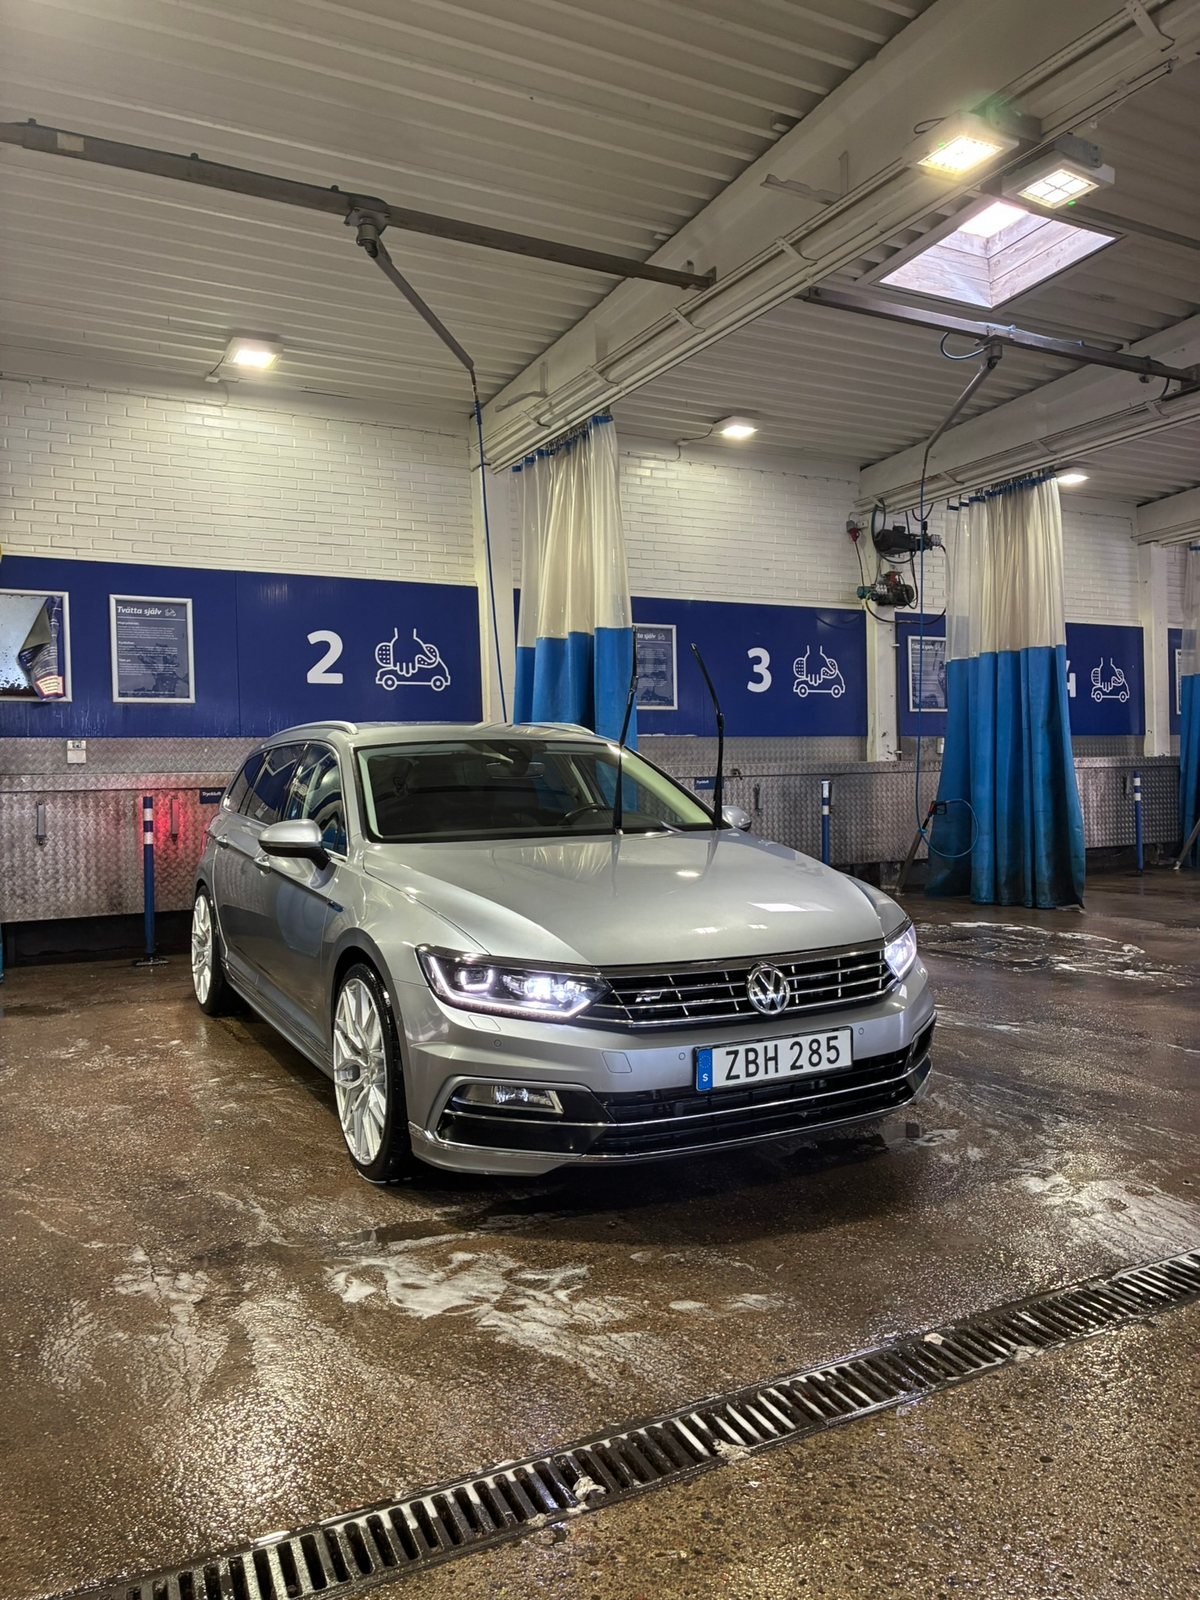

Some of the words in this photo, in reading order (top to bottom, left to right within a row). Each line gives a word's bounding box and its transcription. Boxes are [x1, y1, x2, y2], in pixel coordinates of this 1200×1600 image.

[117, 606, 142, 614] Tvätta
[144, 607, 162, 616] själv
[307, 630, 343, 684] 2
[747, 647, 772, 693] 3
[702, 1073, 709, 1082] S
[725, 1043, 779, 1082] ZBH
[789, 1035, 840, 1071] 285
